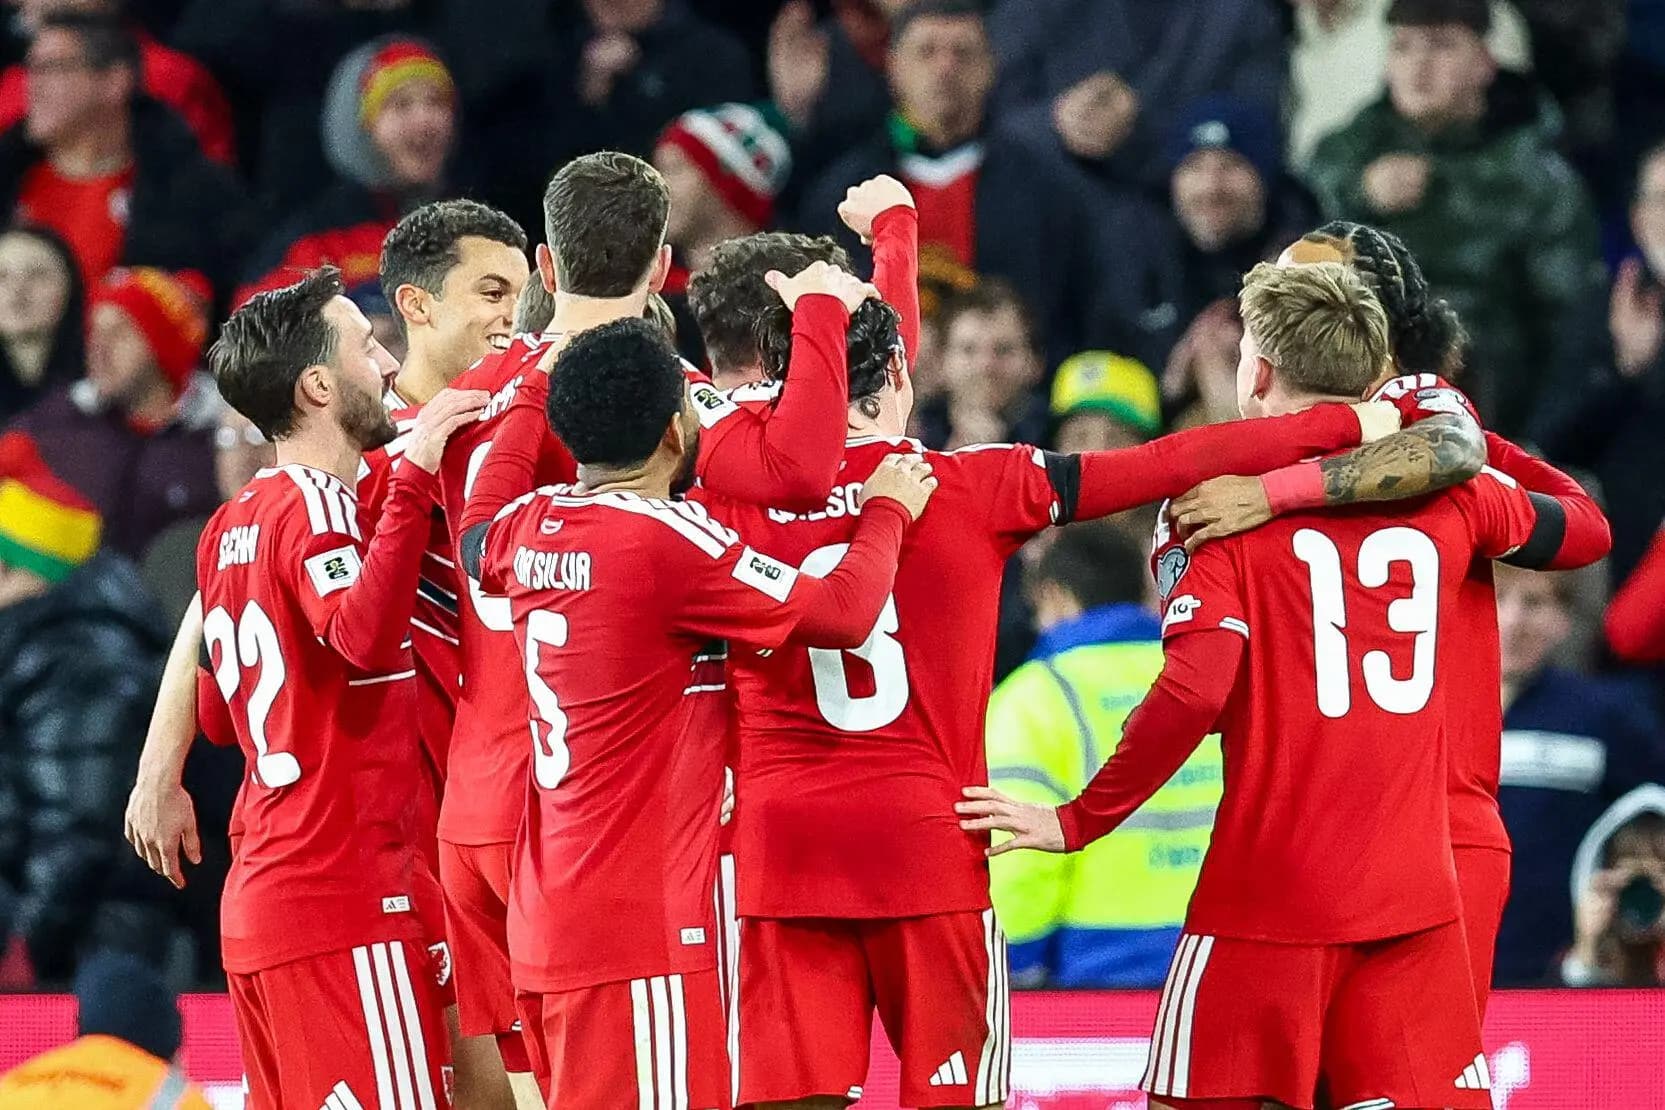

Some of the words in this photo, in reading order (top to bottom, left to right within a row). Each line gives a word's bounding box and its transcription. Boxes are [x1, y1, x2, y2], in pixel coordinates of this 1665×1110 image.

[203, 598, 302, 788] 22
[524, 608, 571, 790] 5
[1291, 526, 1440, 718] 13
